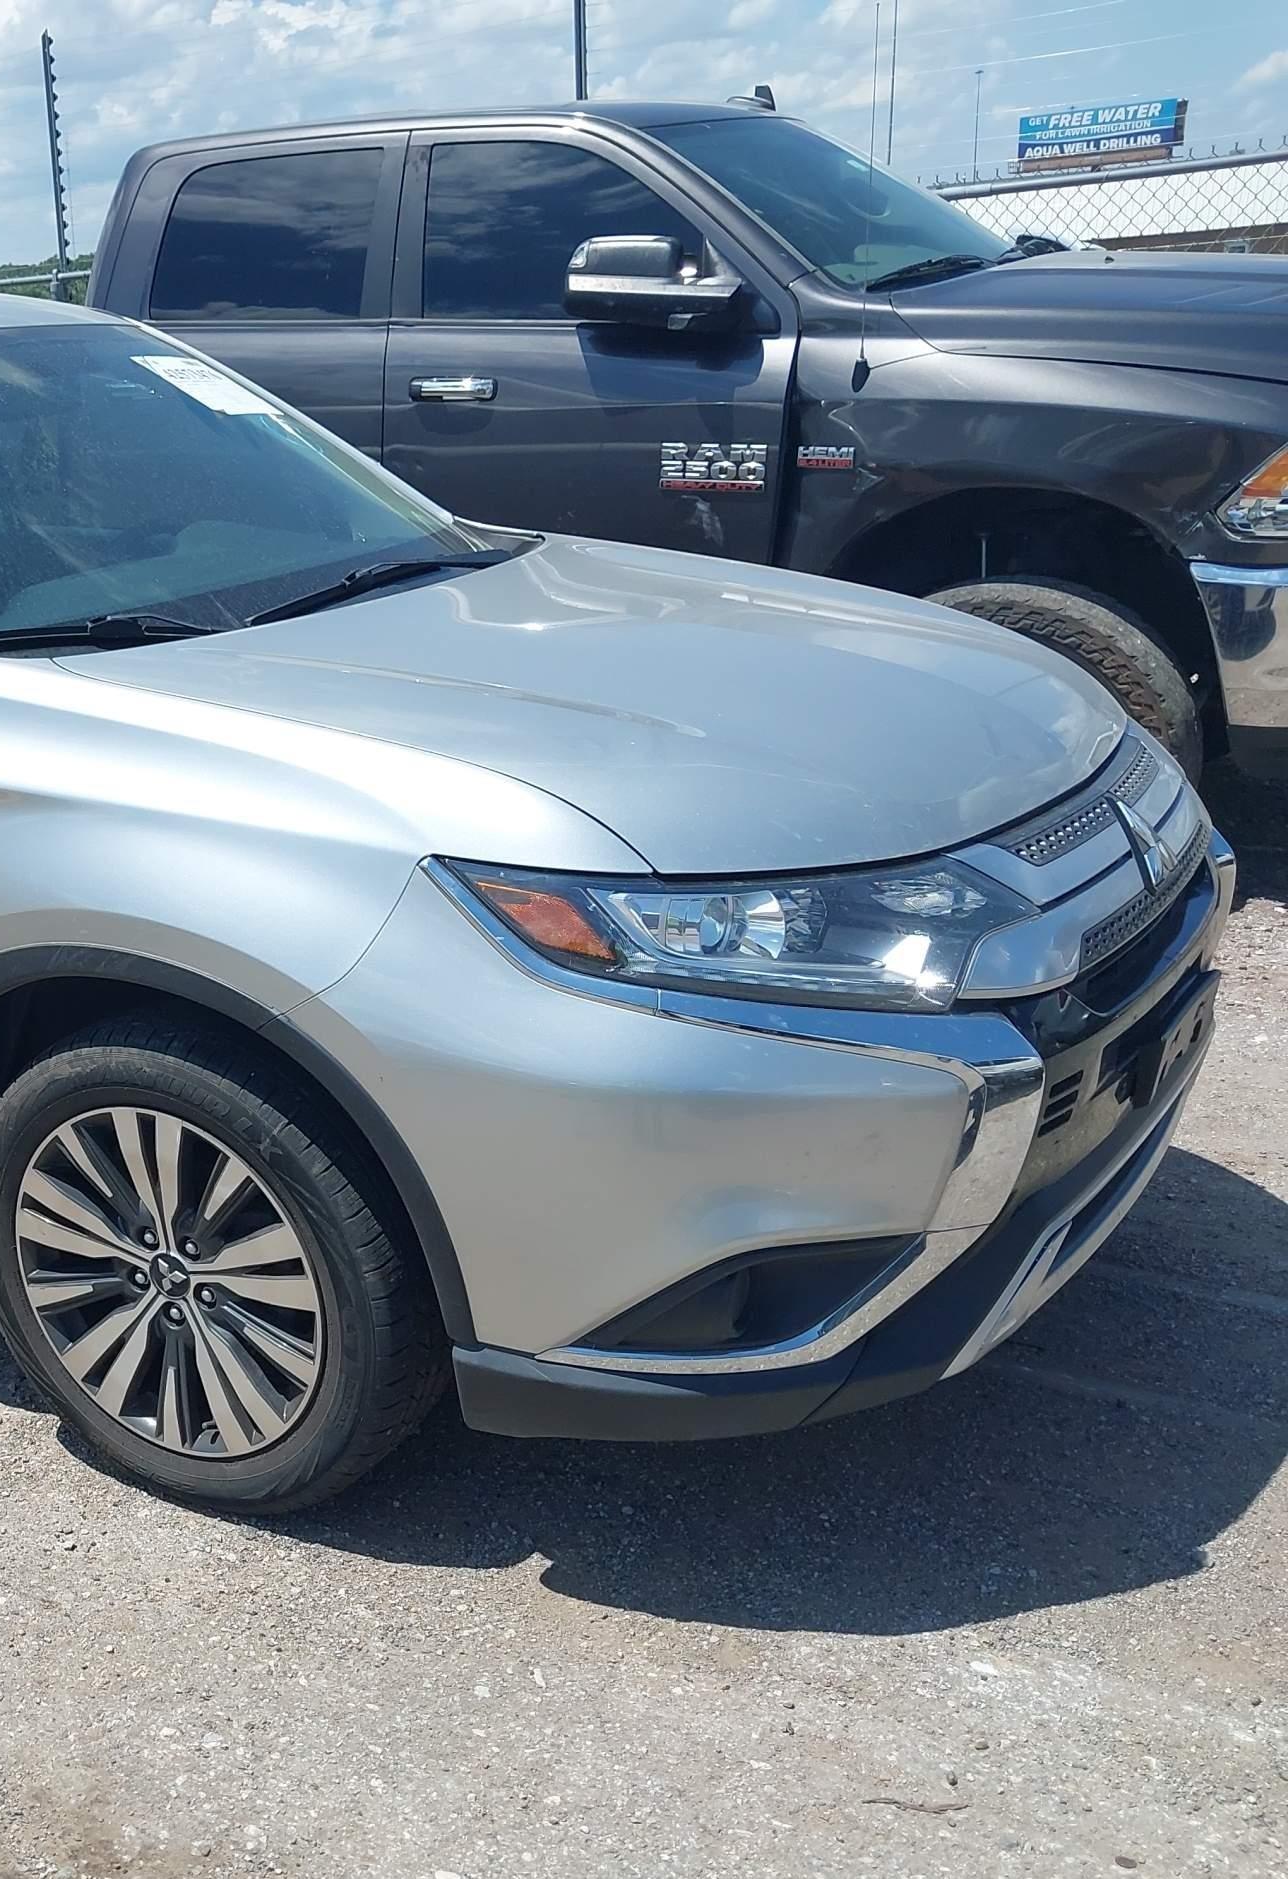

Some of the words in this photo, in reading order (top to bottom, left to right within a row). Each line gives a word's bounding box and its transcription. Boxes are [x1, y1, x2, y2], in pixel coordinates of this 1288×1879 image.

[1028, 117, 1048, 127] GET
[1048, 110, 1095, 129] FREE
[1098, 102, 1162, 123] WATER
[1035, 130, 1056, 140] FOR
[1058, 126, 1088, 138] LAWN
[1089, 119, 1152, 135] IRRIGATION
[1024, 144, 1061, 159] AQUA
[1063, 141, 1097, 155] WELL
[1099, 133, 1161, 152] DRILLING
[660, 442, 768, 462] RAM
[798, 446, 855, 458] HEMI
[660, 460, 766, 480] 2500
[819, 458, 852, 468] LITER
[663, 480, 713, 490] HEAVY
[715, 481, 761, 491] DUTY
